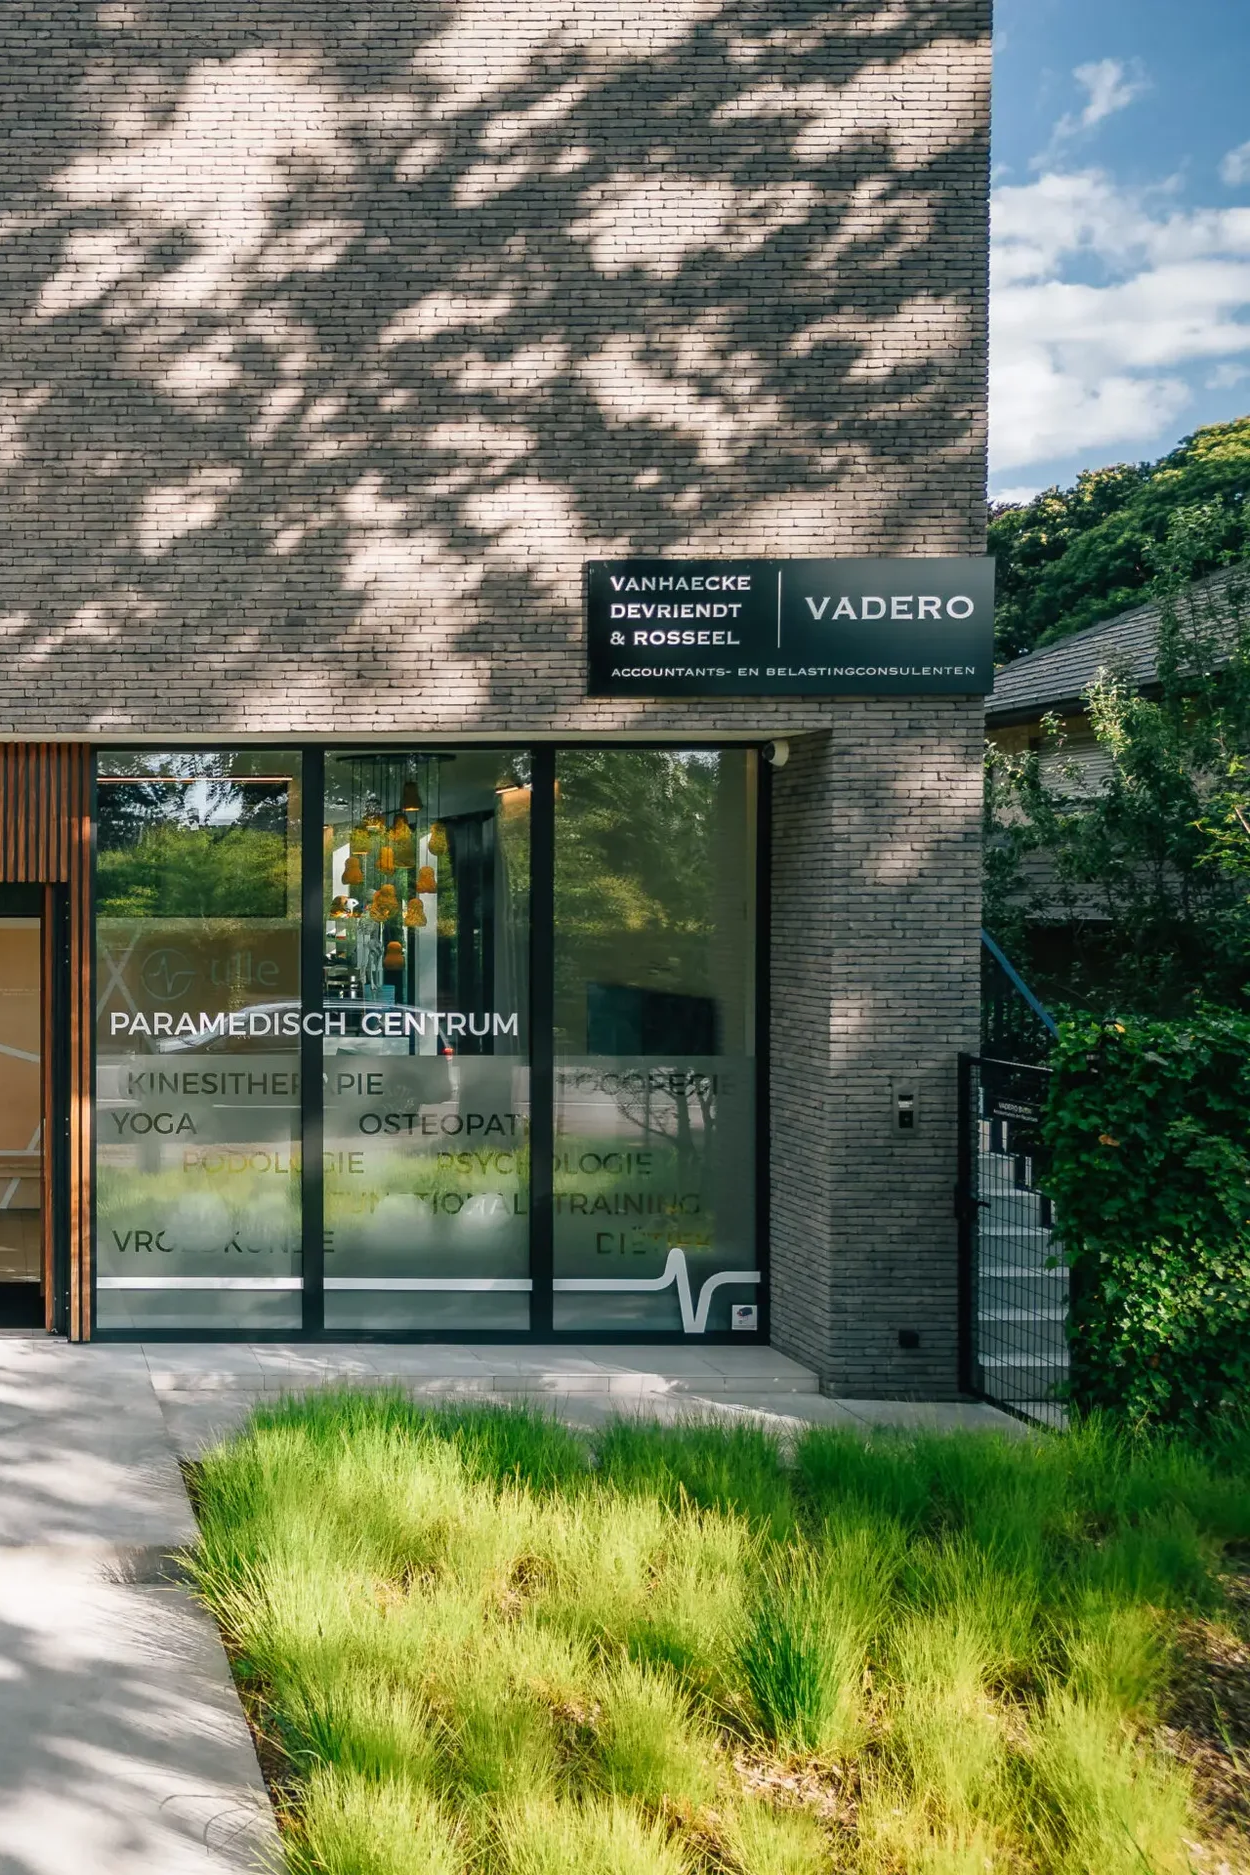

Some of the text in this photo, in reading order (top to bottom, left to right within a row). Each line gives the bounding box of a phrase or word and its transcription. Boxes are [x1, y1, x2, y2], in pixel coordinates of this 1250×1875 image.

[609, 575, 751, 592] VANHAECKE
[609, 603, 743, 619] DEVRIENDT
[804, 595, 975, 621] VADERO
[609, 630, 741, 646] & ROSSEEL
[610, 665, 976, 678] ACCOUNTANTS- EN BELASTINGCONSULENTEN
[108, 1011, 520, 1037] PARAMEDISCH CENTRUM
[127, 1071, 385, 1096] KINESITHERPIE
[111, 1112, 198, 1136] YOGA
[436, 1152, 654, 1176] PSYCHLOGIE
[553, 1192, 701, 1216] TRAINING
